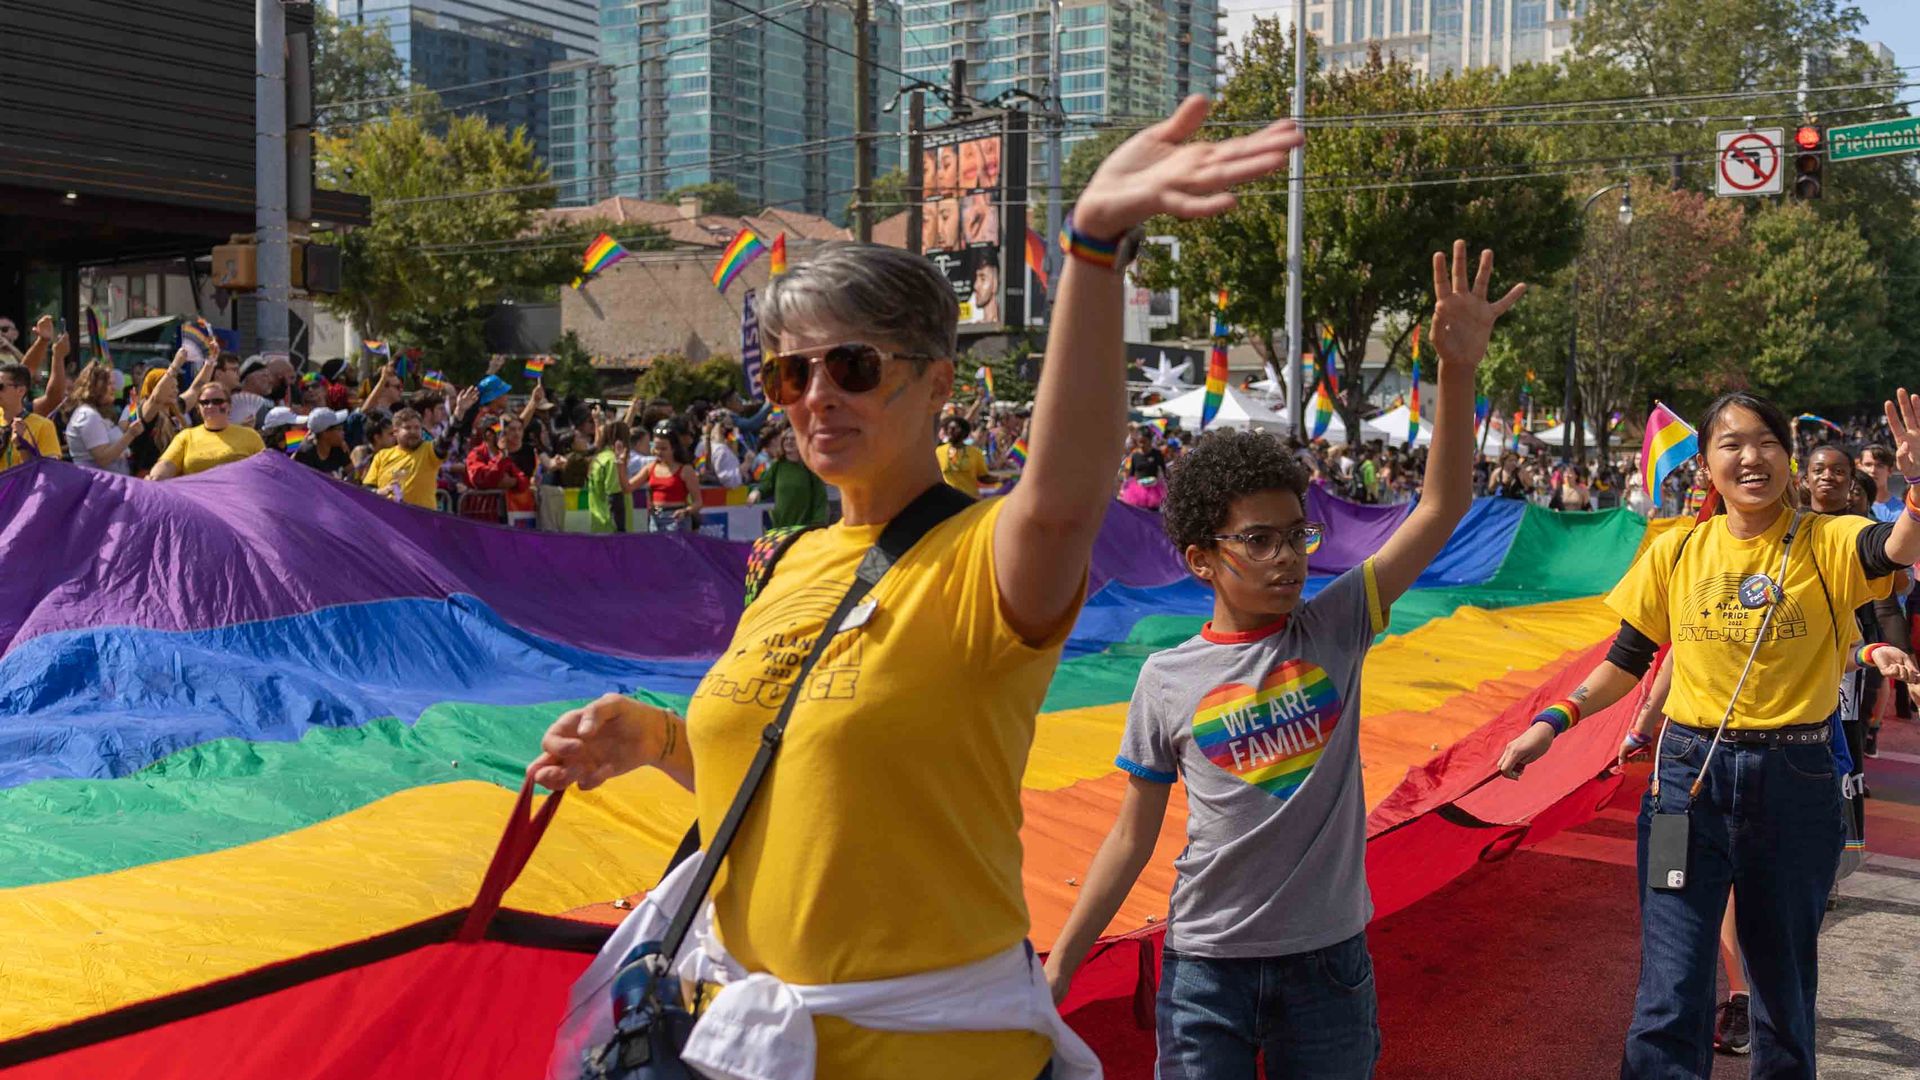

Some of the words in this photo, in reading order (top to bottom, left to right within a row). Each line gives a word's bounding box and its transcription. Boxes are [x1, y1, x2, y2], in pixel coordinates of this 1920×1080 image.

[1834, 123, 1920, 154] Piedmont
[1722, 611, 1749, 620] PRIDE
[762, 633, 815, 650] ATLAN
[1220, 705, 1264, 737] WE
[1270, 685, 1317, 725] ARE
[1229, 713, 1324, 770] FAMILY
